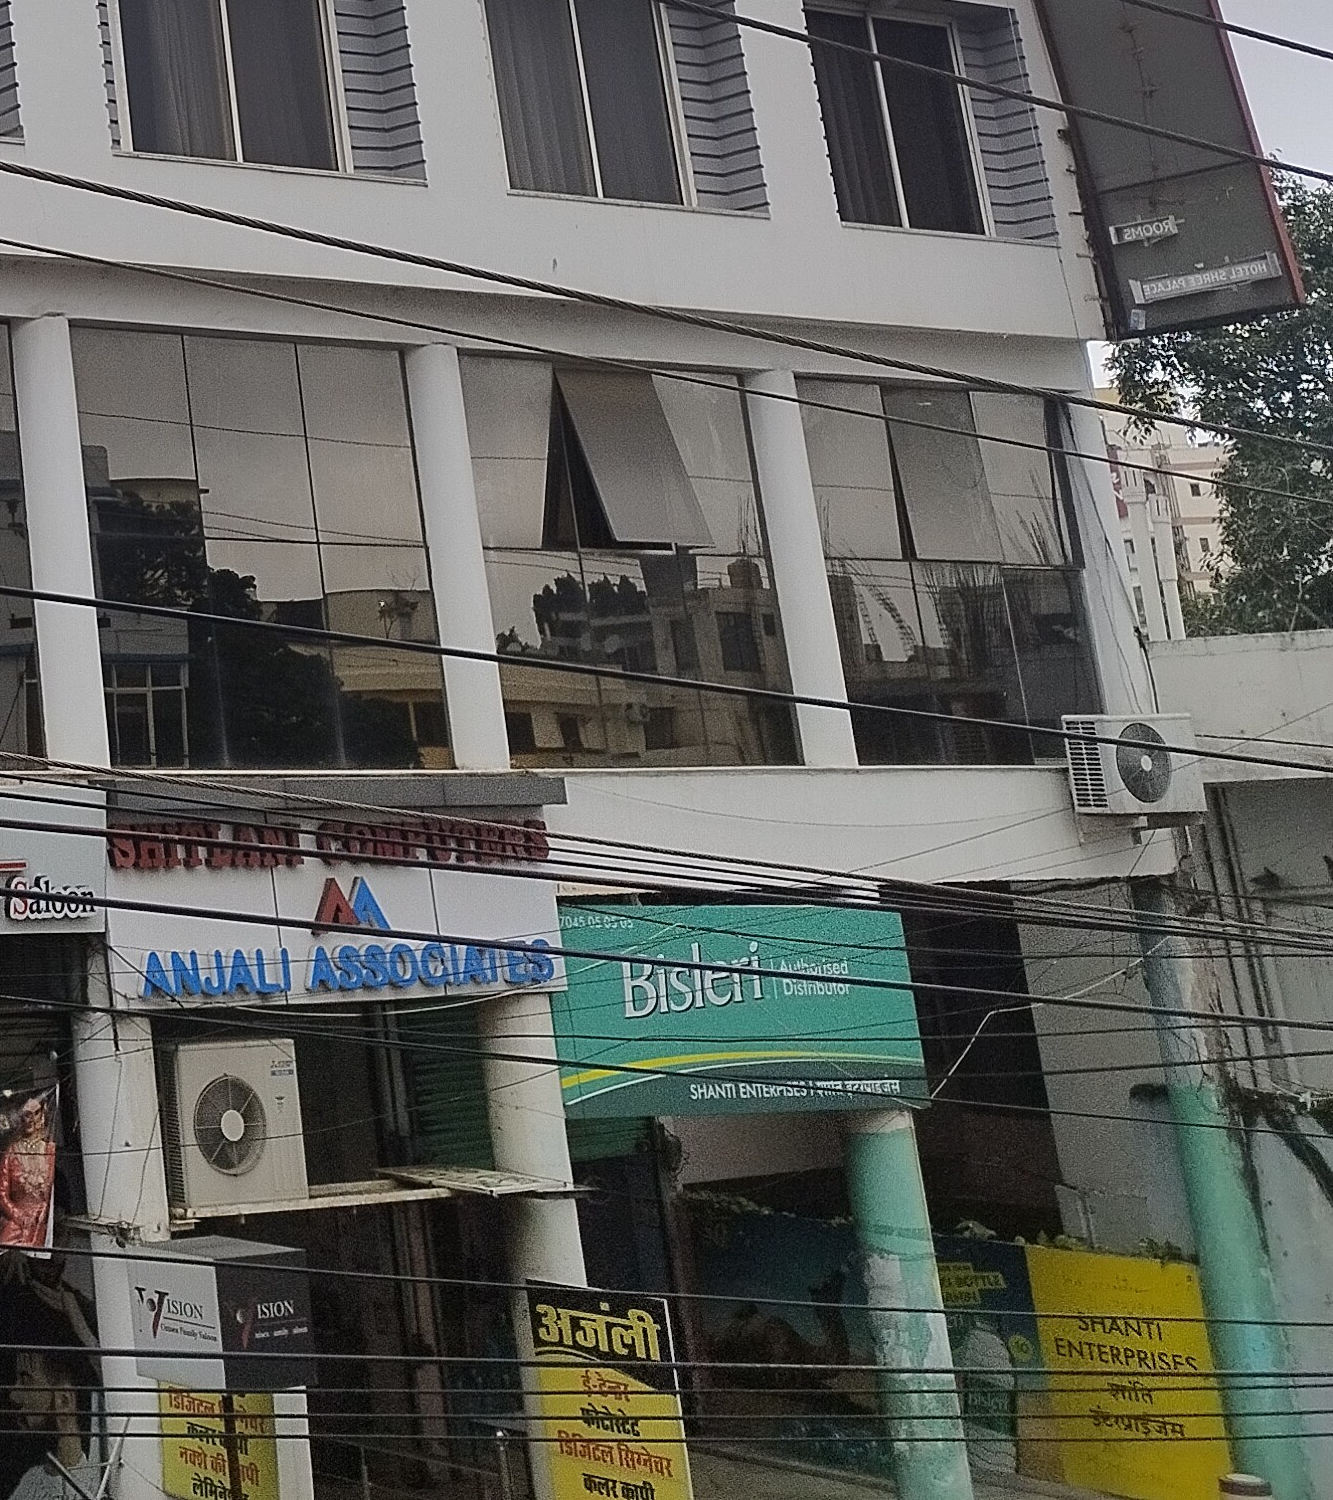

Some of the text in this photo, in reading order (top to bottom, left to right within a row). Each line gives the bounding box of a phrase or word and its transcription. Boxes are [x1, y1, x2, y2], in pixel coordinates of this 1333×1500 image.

[140, 938, 555, 998] ANJALI ASSOCIATES
[621, 941, 765, 1019] Bisleri
[690, 1082, 736, 1099] SHANTI
[1078, 1316, 1164, 1342] SHANTI
[1054, 1337, 1199, 1372] ENTERPRISES
